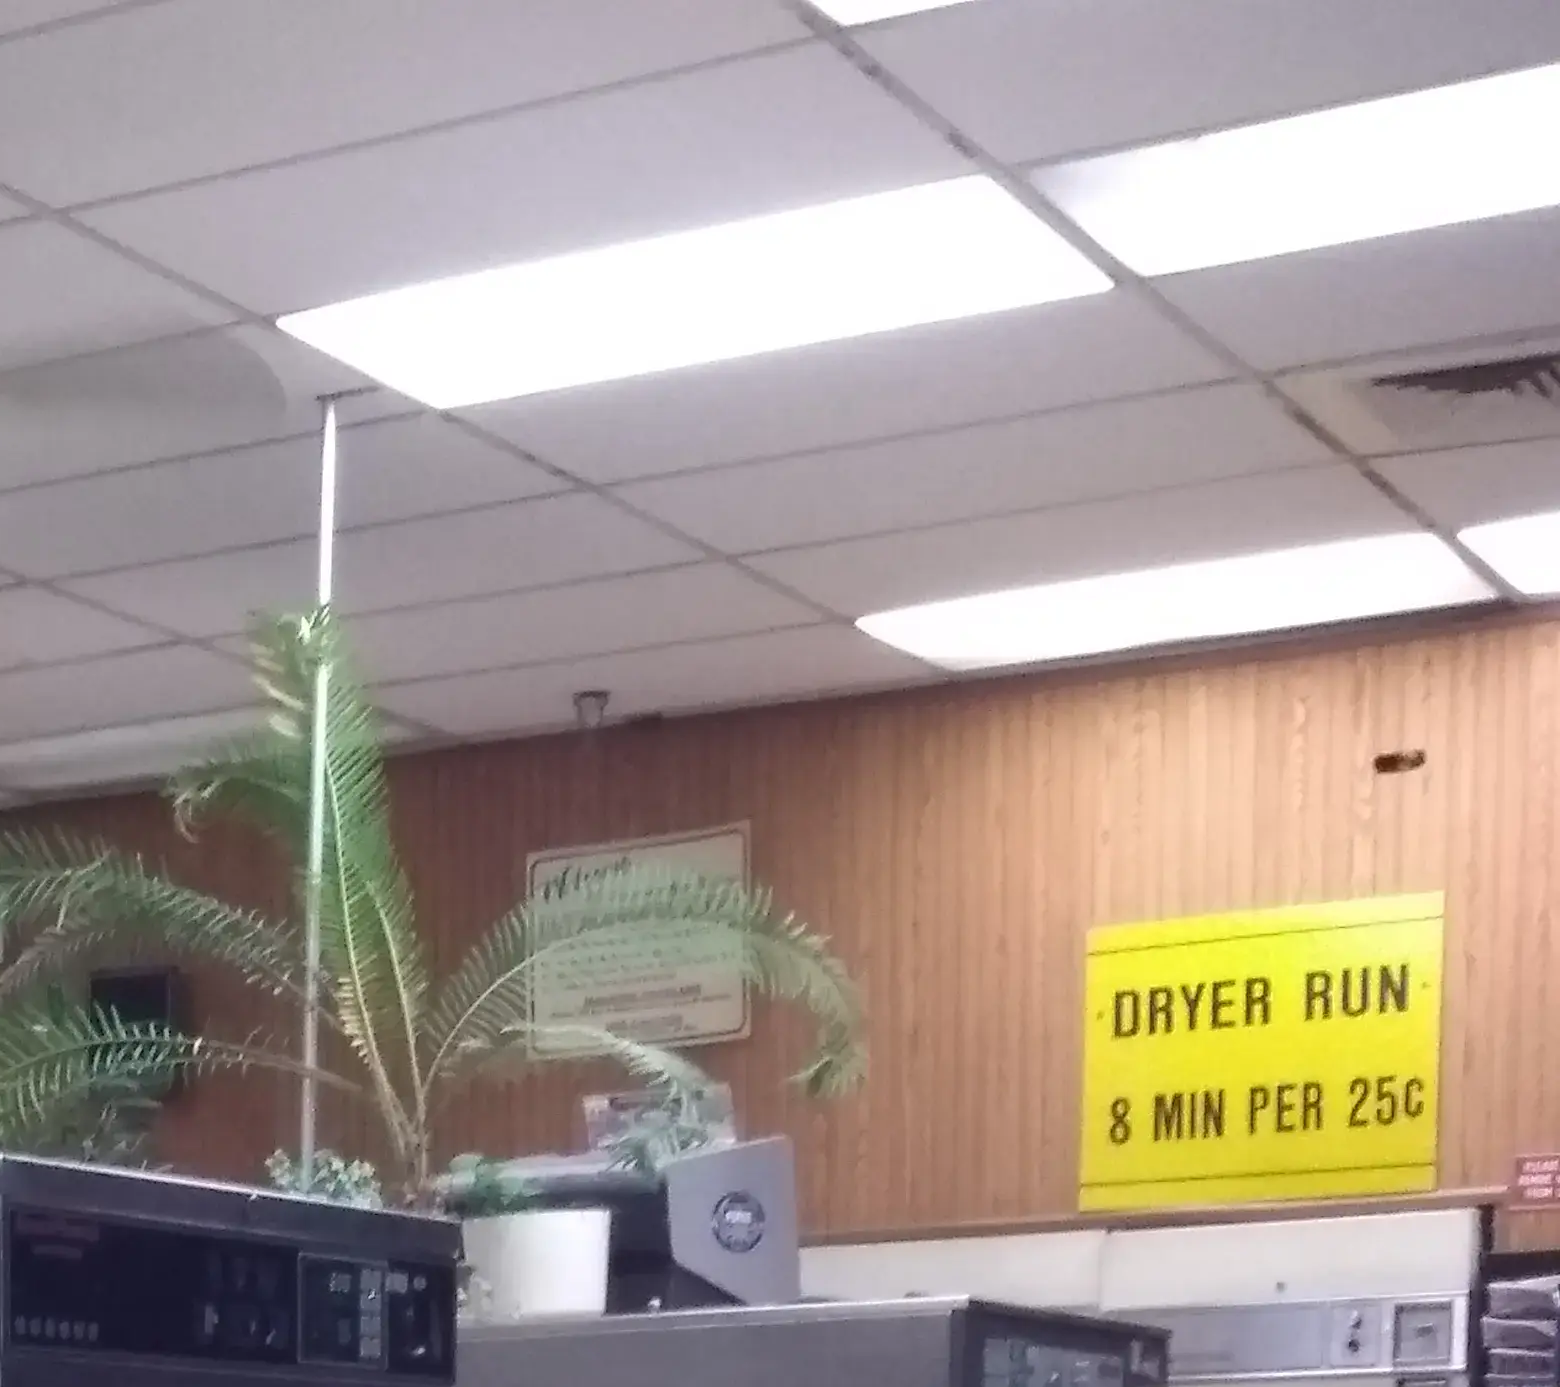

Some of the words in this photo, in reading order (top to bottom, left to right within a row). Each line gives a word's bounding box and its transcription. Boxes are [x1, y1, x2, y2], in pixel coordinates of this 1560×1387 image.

[1113, 976, 1273, 1039] DRYER
[1304, 963, 1410, 1021] RUN
[1109, 1097, 1131, 1145] 8
[1153, 1088, 1225, 1142] MIN
[1248, 1079, 1325, 1136] PER
